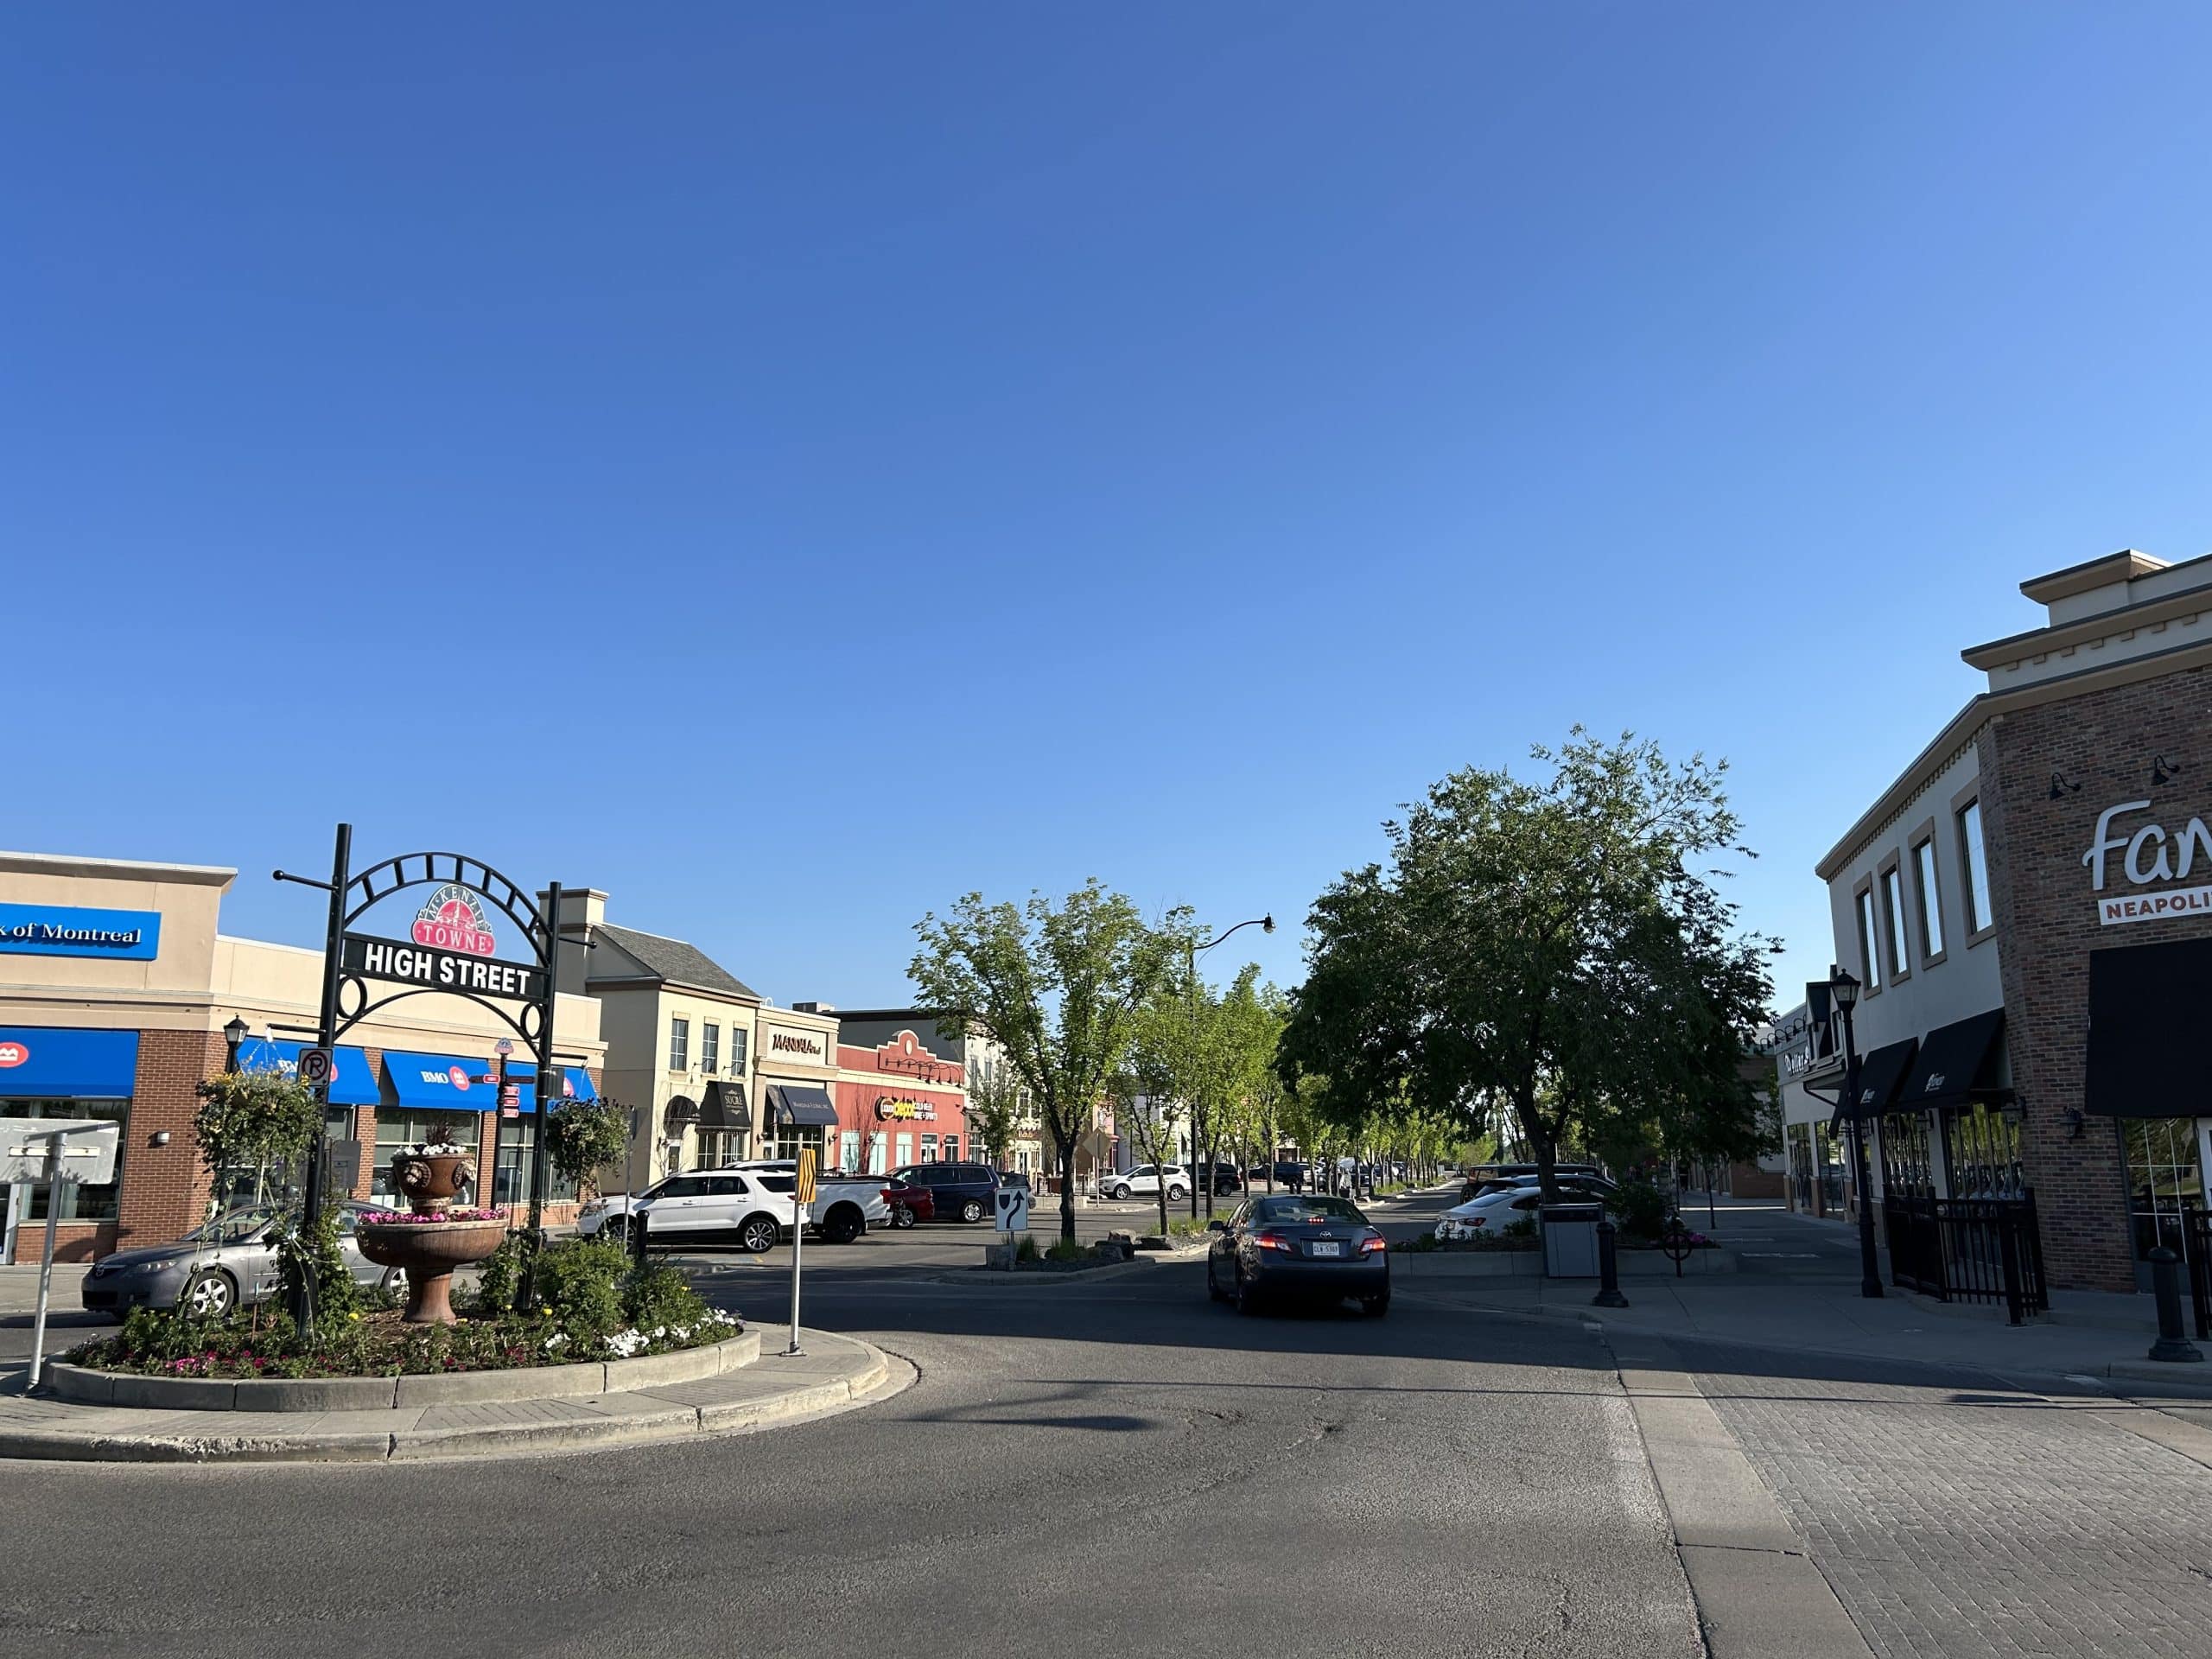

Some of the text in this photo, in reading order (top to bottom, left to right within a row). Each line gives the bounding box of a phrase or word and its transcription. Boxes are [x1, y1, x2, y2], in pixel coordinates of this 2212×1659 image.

[2106, 892, 2212, 919] NEAPOLI
[13, 922, 36, 938] of
[41, 923, 142, 944] Montreal
[423, 925, 487, 952] TOWNE
[365, 943, 531, 995] HIGH STREET
[309, 1057, 323, 1075] P
[420, 1071, 449, 1084] BMO
